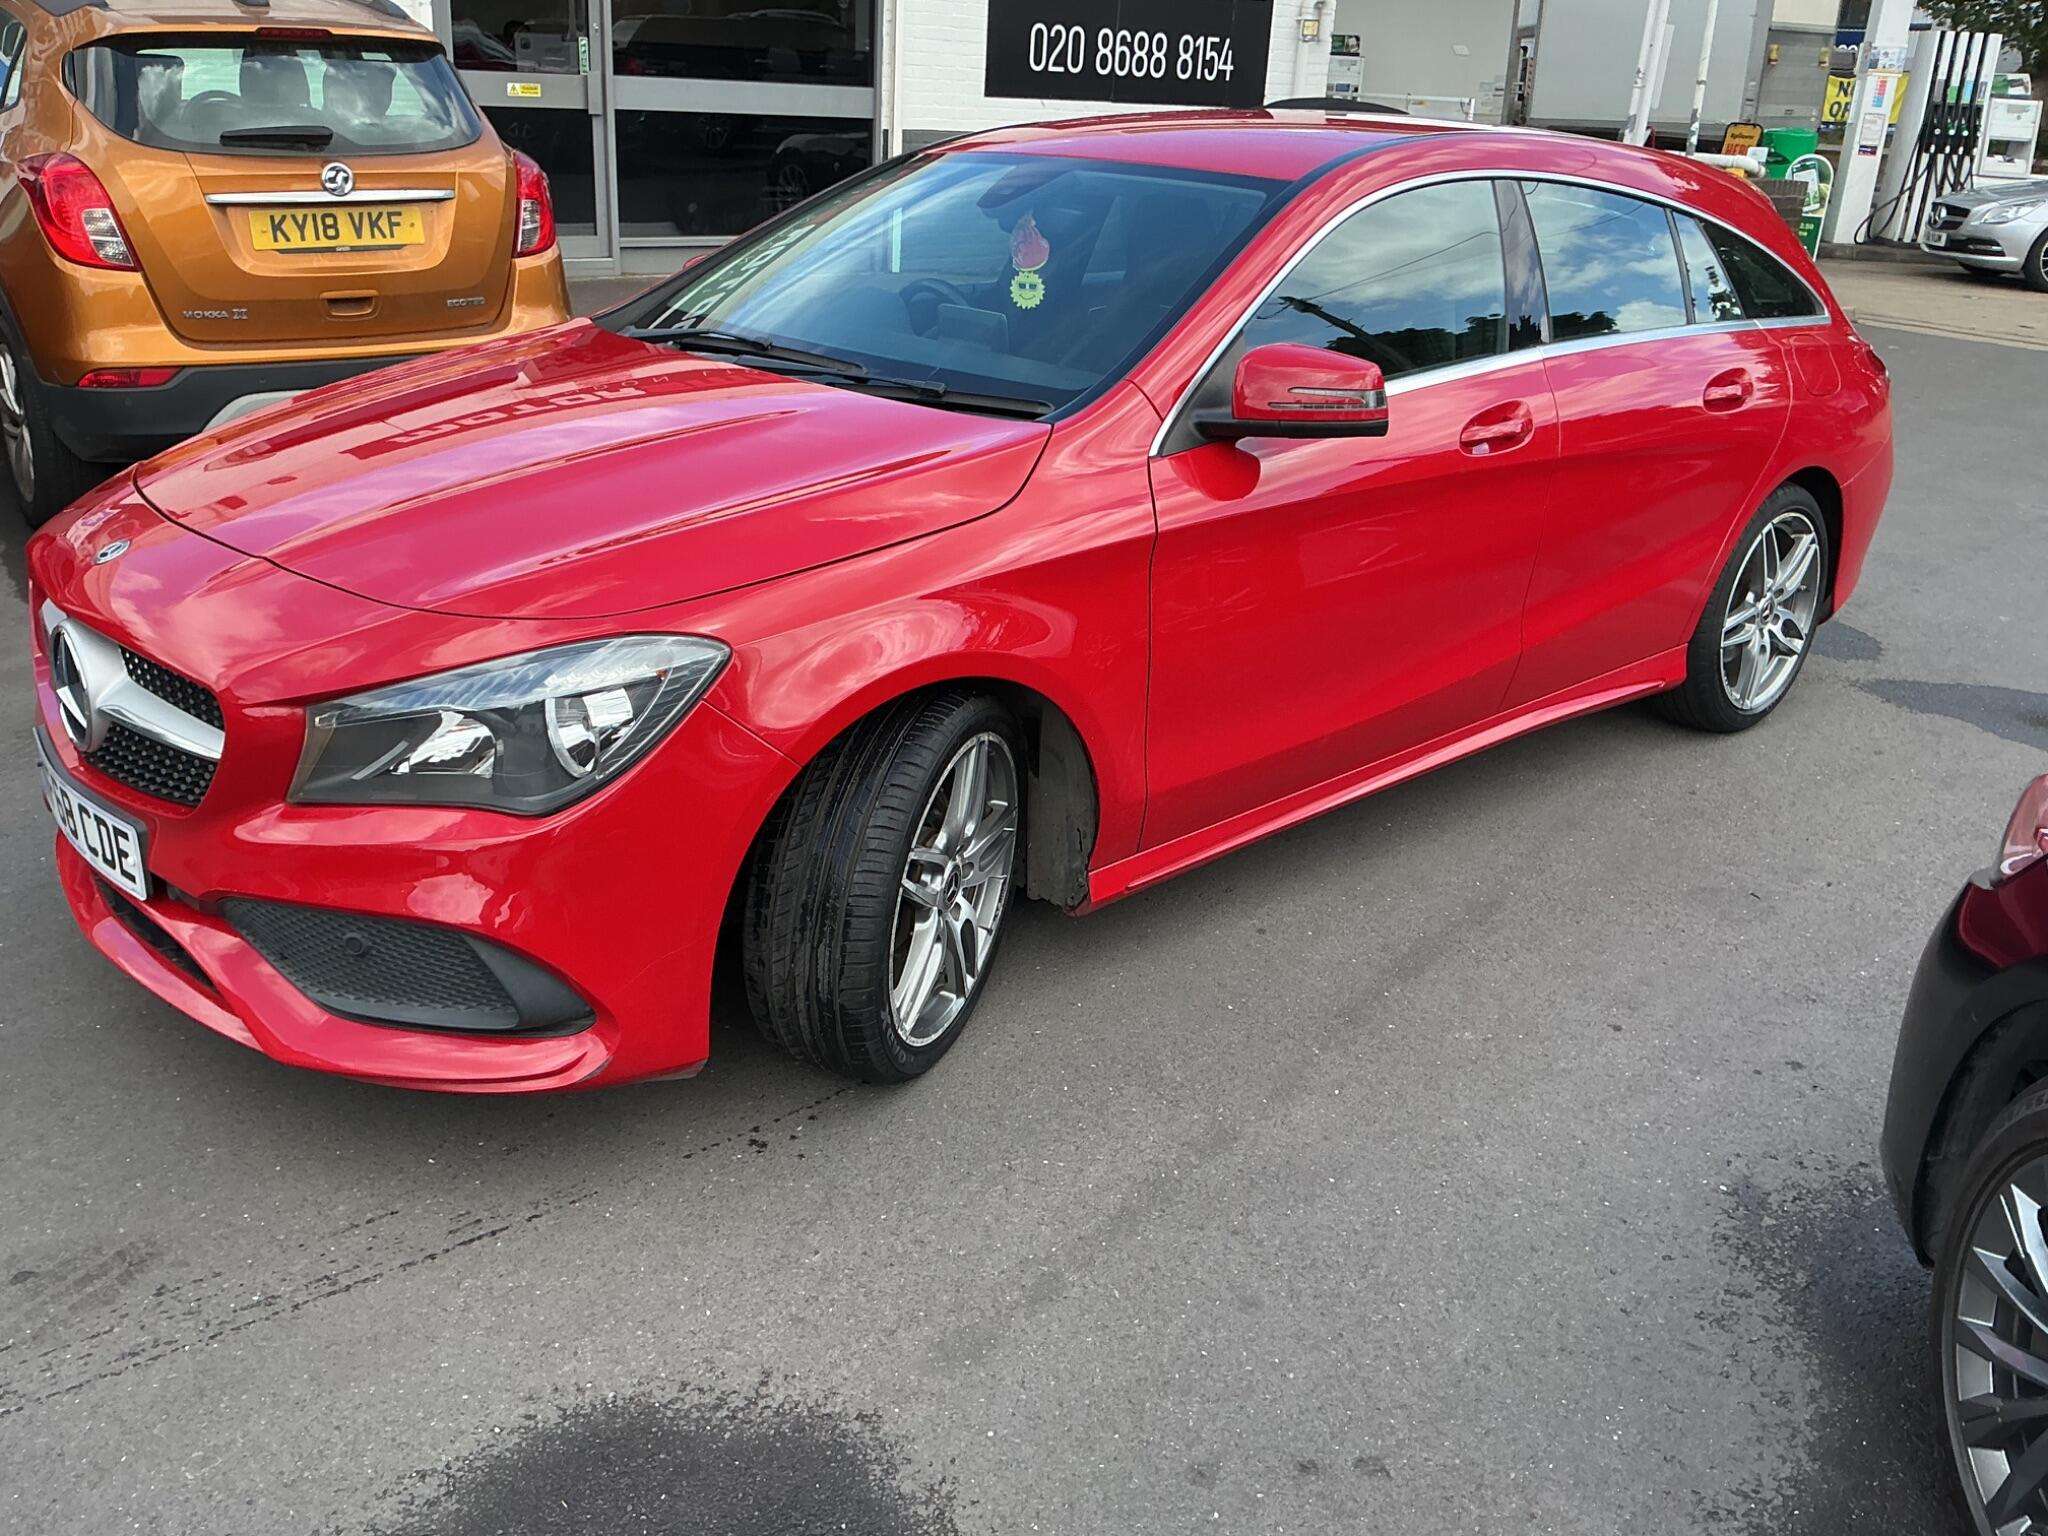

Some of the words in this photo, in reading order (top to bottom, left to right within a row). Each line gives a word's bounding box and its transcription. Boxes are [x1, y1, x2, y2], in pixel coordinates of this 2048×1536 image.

[1029, 22, 1086, 74] 020
[1095, 27, 1168, 79] 8688
[1176, 34, 1235, 82] 8154
[269, 212, 340, 243] KY18
[347, 210, 403, 240] VKF
[77, 802, 138, 885] CDE
